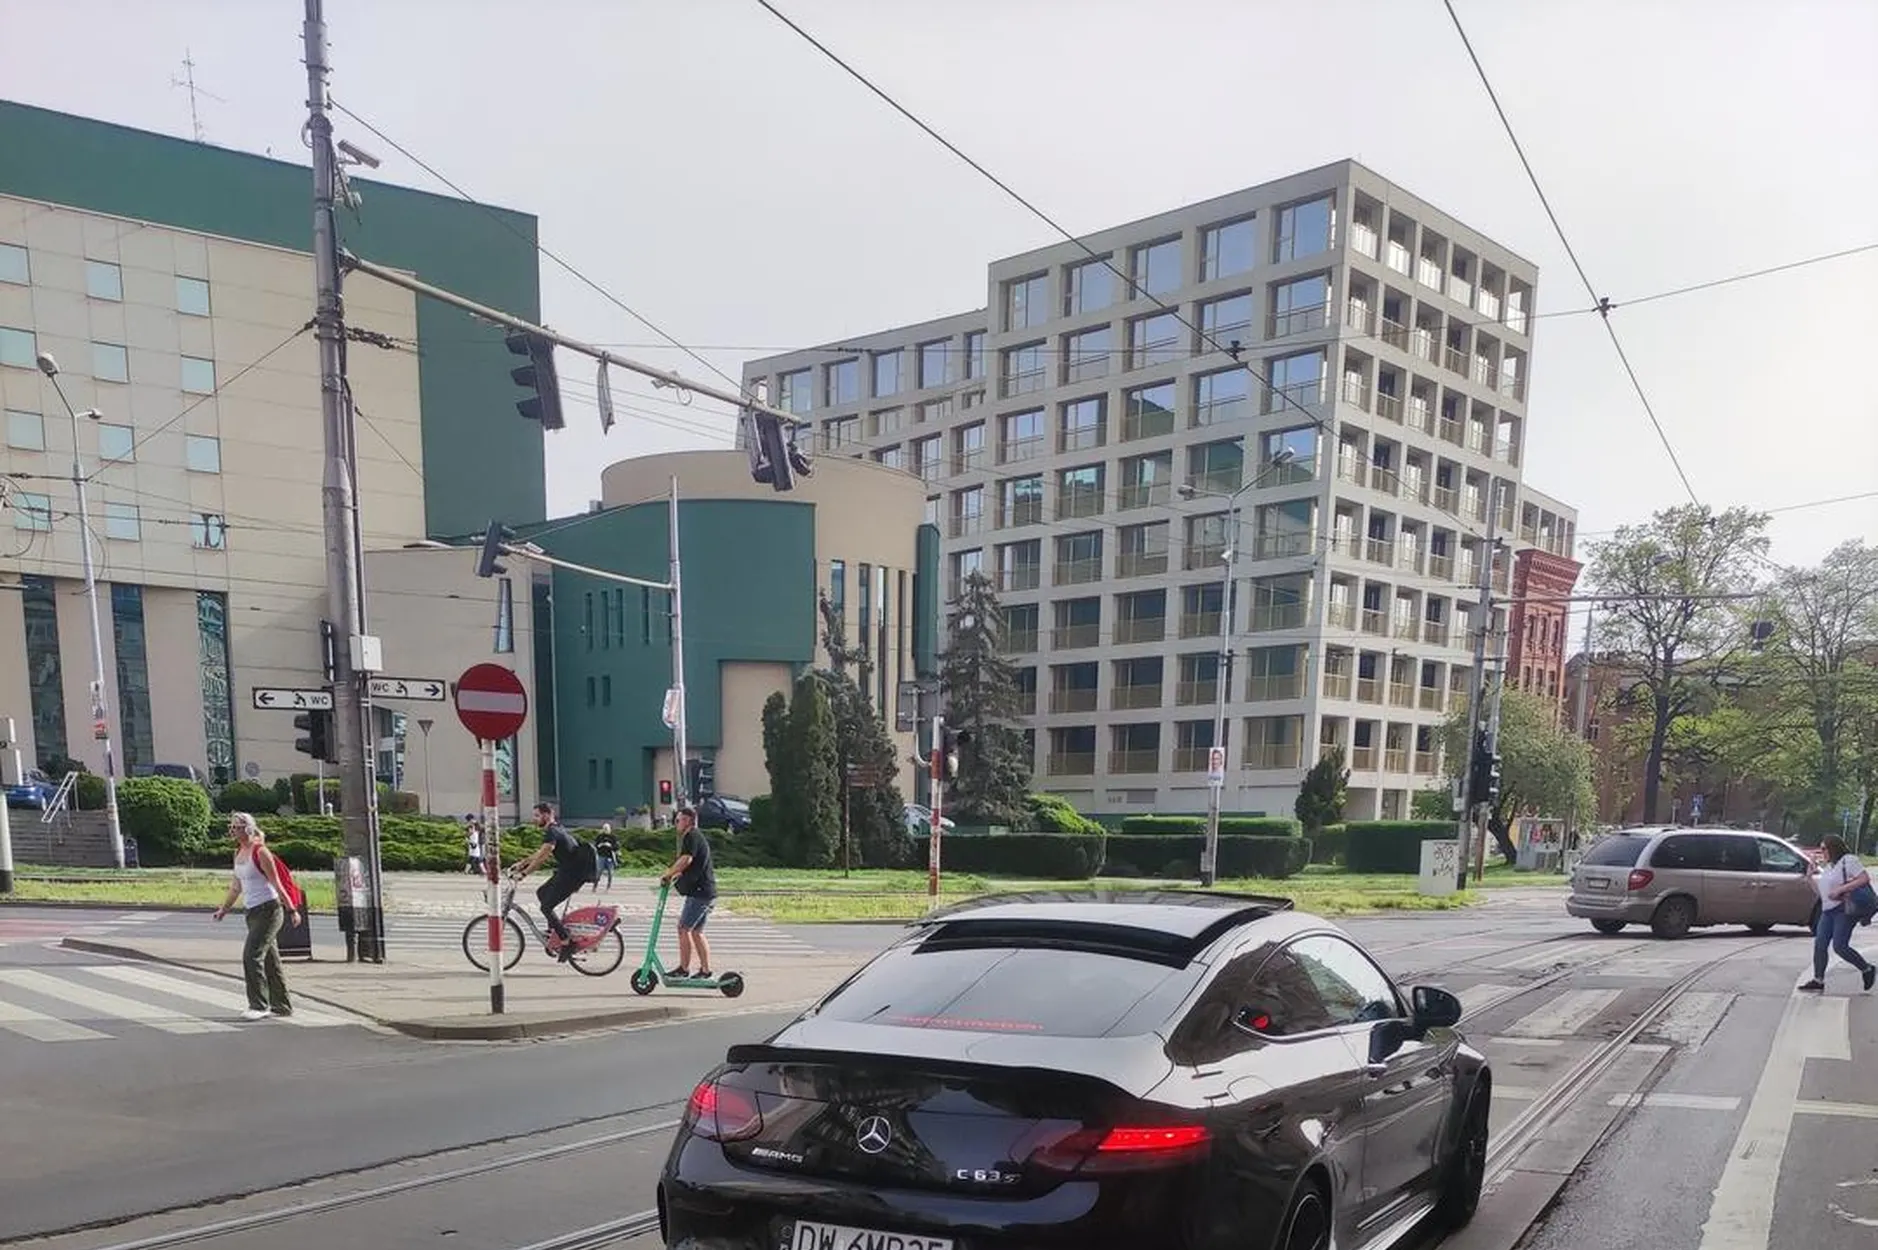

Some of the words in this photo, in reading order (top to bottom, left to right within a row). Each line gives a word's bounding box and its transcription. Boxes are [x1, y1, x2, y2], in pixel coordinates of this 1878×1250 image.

[371, 682, 389, 693] WC
[311, 696, 328, 706] WC
[766, 1149, 804, 1163] AMG
[956, 1169, 969, 1180] C
[974, 1169, 1001, 1182] 63
